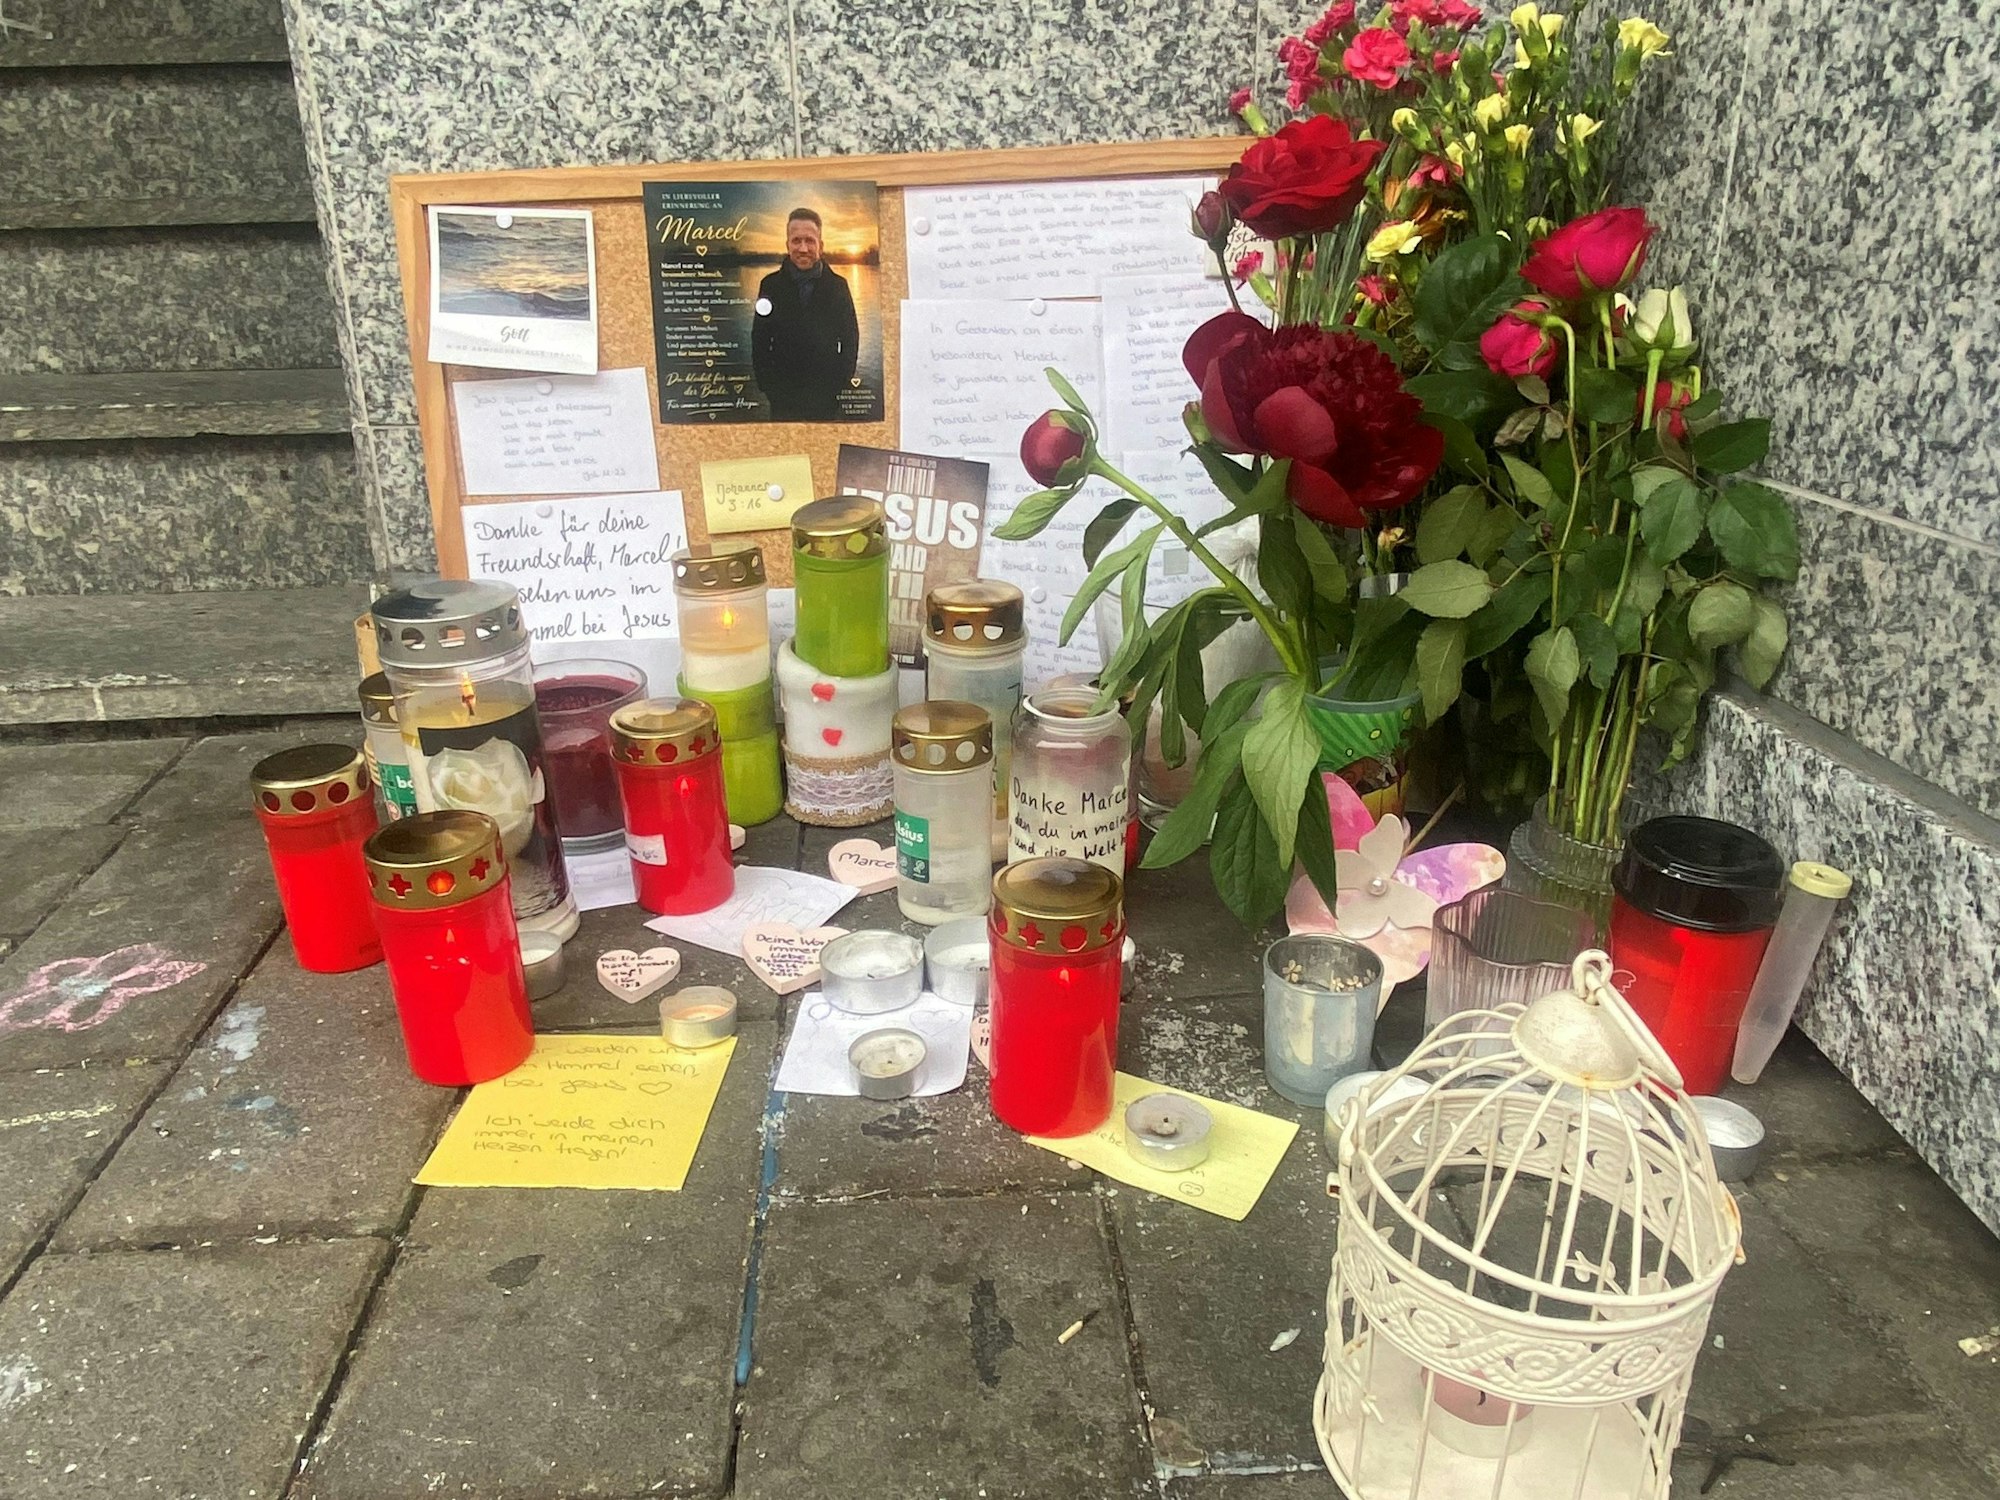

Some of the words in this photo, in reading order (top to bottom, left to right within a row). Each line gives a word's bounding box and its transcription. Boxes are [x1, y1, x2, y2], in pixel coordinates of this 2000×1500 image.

[655, 214, 749, 246] Marcel
[930, 322, 943, 335] In
[955, 320, 1017, 336] Gedenken
[1022, 325, 1041, 335] an
[473, 516, 544, 541] Danke
[560, 509, 590, 542] für
[598, 507, 650, 533] deine
[476, 541, 603, 574] Freundschaft,
[890, 542, 928, 573] AID
[518, 578, 571, 604] sehen
[574, 586, 617, 601] uns
[628, 576, 662, 596] im
[528, 612, 576, 641] mmel
[581, 610, 607, 636] bei
[622, 604, 672, 638] Jesus
[1013, 776, 1067, 816] Danke
[1038, 821, 1060, 839] du
[1069, 824, 1088, 841] in
[1083, 838, 1117, 860] Welt
[838, 851, 897, 870] Marce
[756, 933, 796, 946] Deine
[768, 944, 820, 954] immer
[566, 1044, 638, 1056] werden
[547, 1058, 621, 1071] Himmel
[485, 1114, 522, 1127] Ich
[532, 1115, 595, 1130] werde
[608, 1116, 666, 1131] dich
[473, 1139, 543, 1153] Herzen
[474, 1129, 536, 1141] immer
[549, 1131, 568, 1141] in
[581, 1133, 655, 1148] meinen
